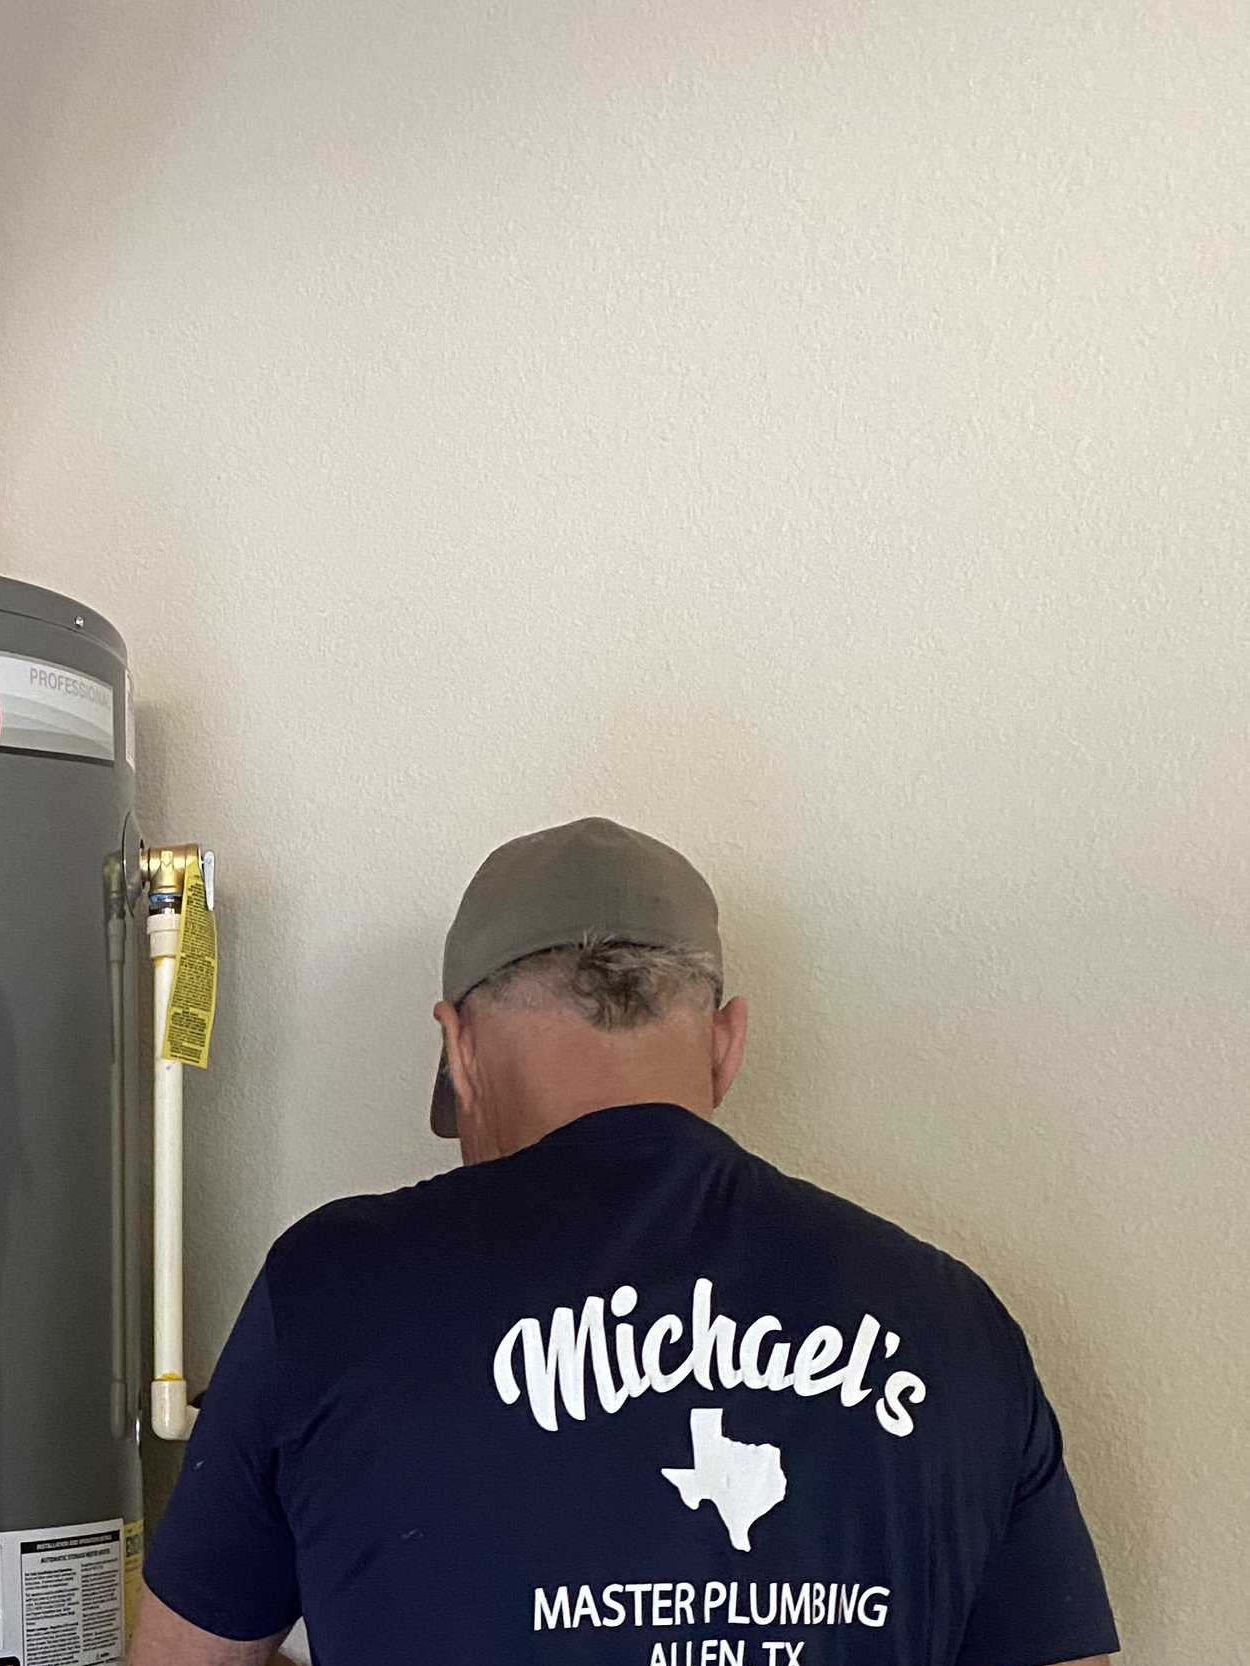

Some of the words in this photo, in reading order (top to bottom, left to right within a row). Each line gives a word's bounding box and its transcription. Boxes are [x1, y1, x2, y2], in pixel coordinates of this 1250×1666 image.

[493, 1277, 927, 1438] Michael's
[533, 1582, 696, 1631] MASTER
[704, 1581, 890, 1627] PLUMBING
